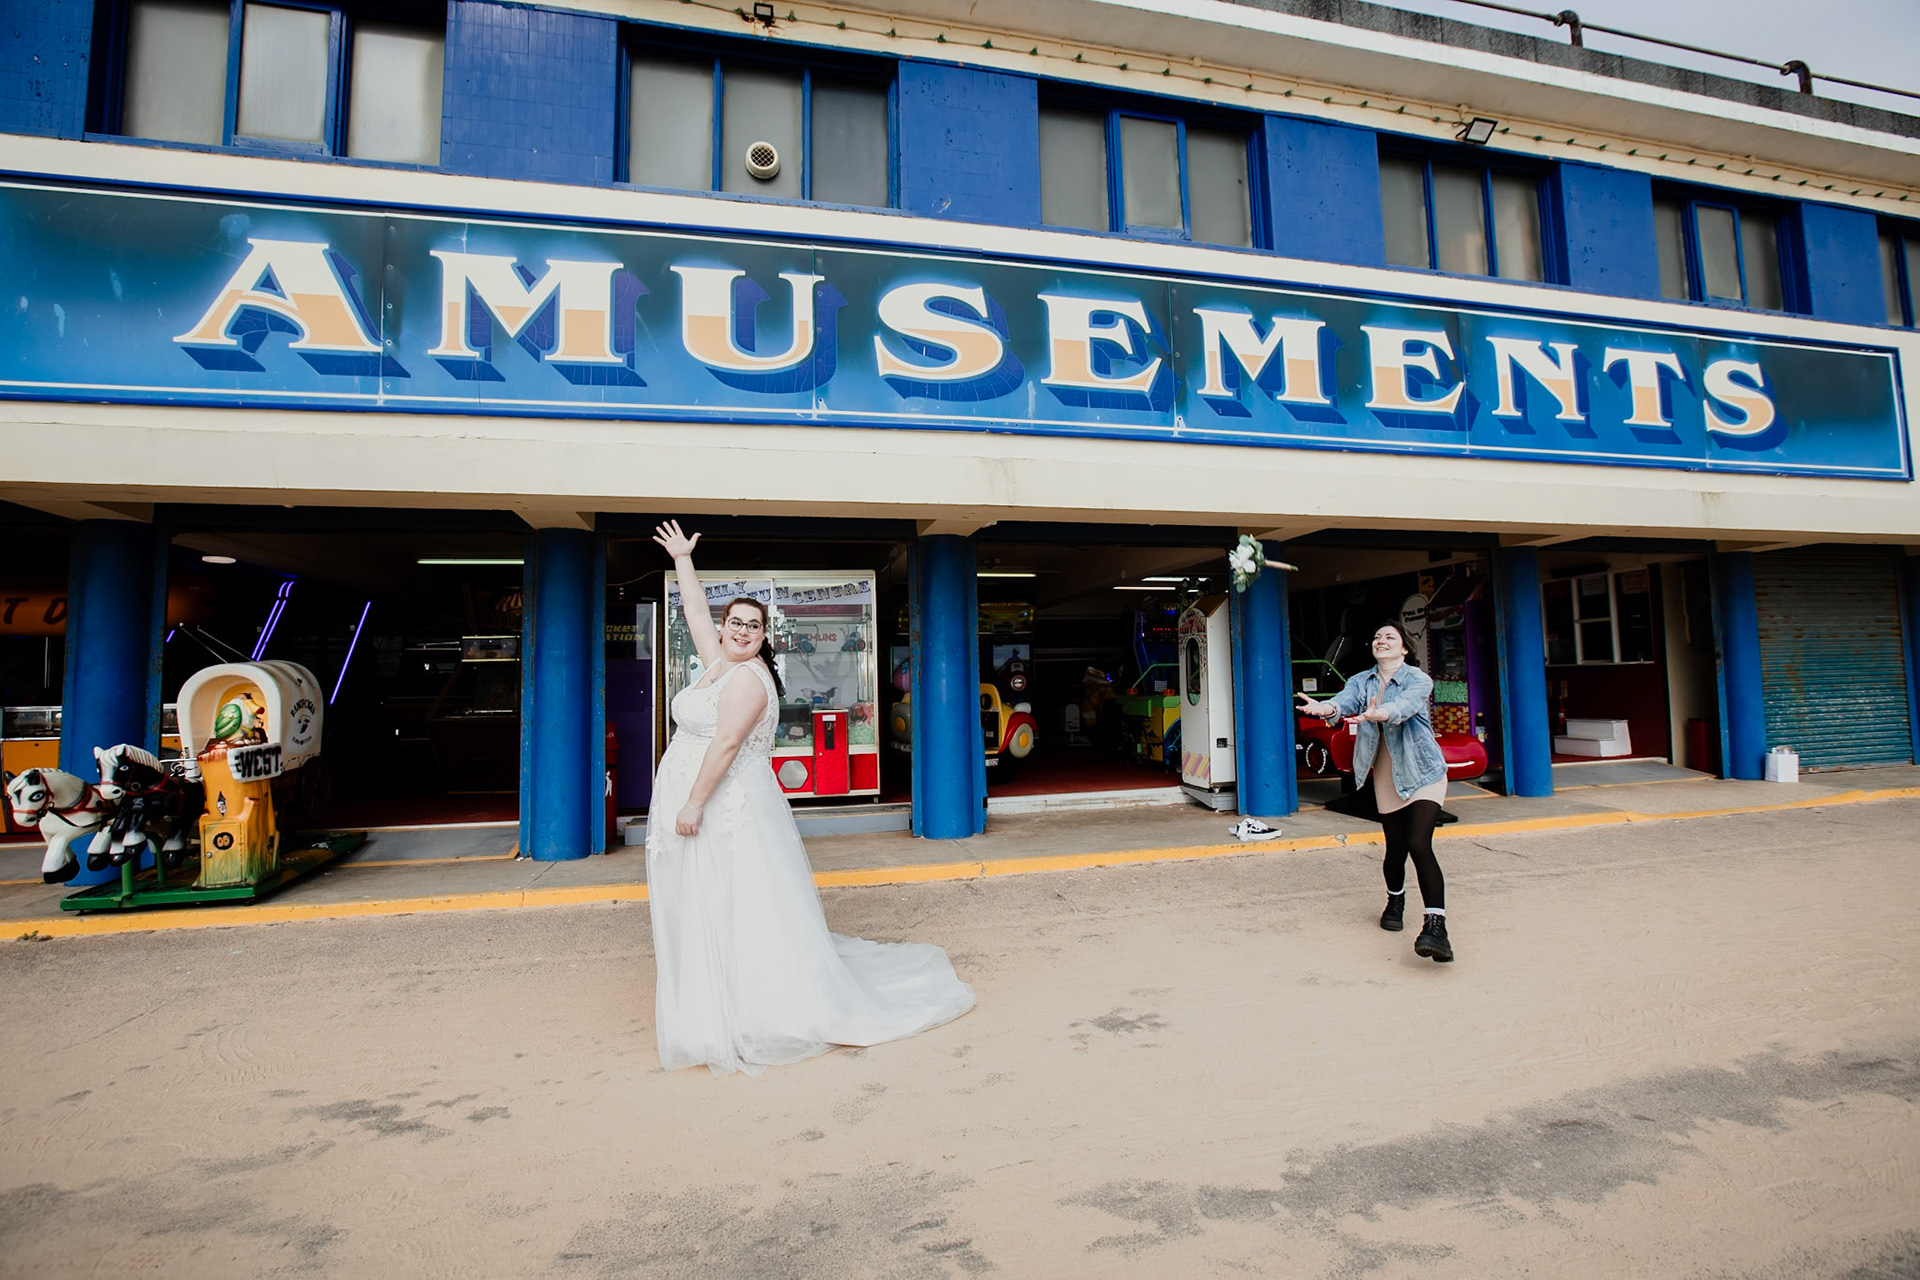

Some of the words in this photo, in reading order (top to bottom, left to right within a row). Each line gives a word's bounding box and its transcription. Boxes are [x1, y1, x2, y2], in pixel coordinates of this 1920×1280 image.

[173, 238, 1778, 440] AMUSEMENTS
[792, 580, 871, 604] CENTRE
[605, 625, 638, 633] CKET
[240, 746, 281, 777] WEST
